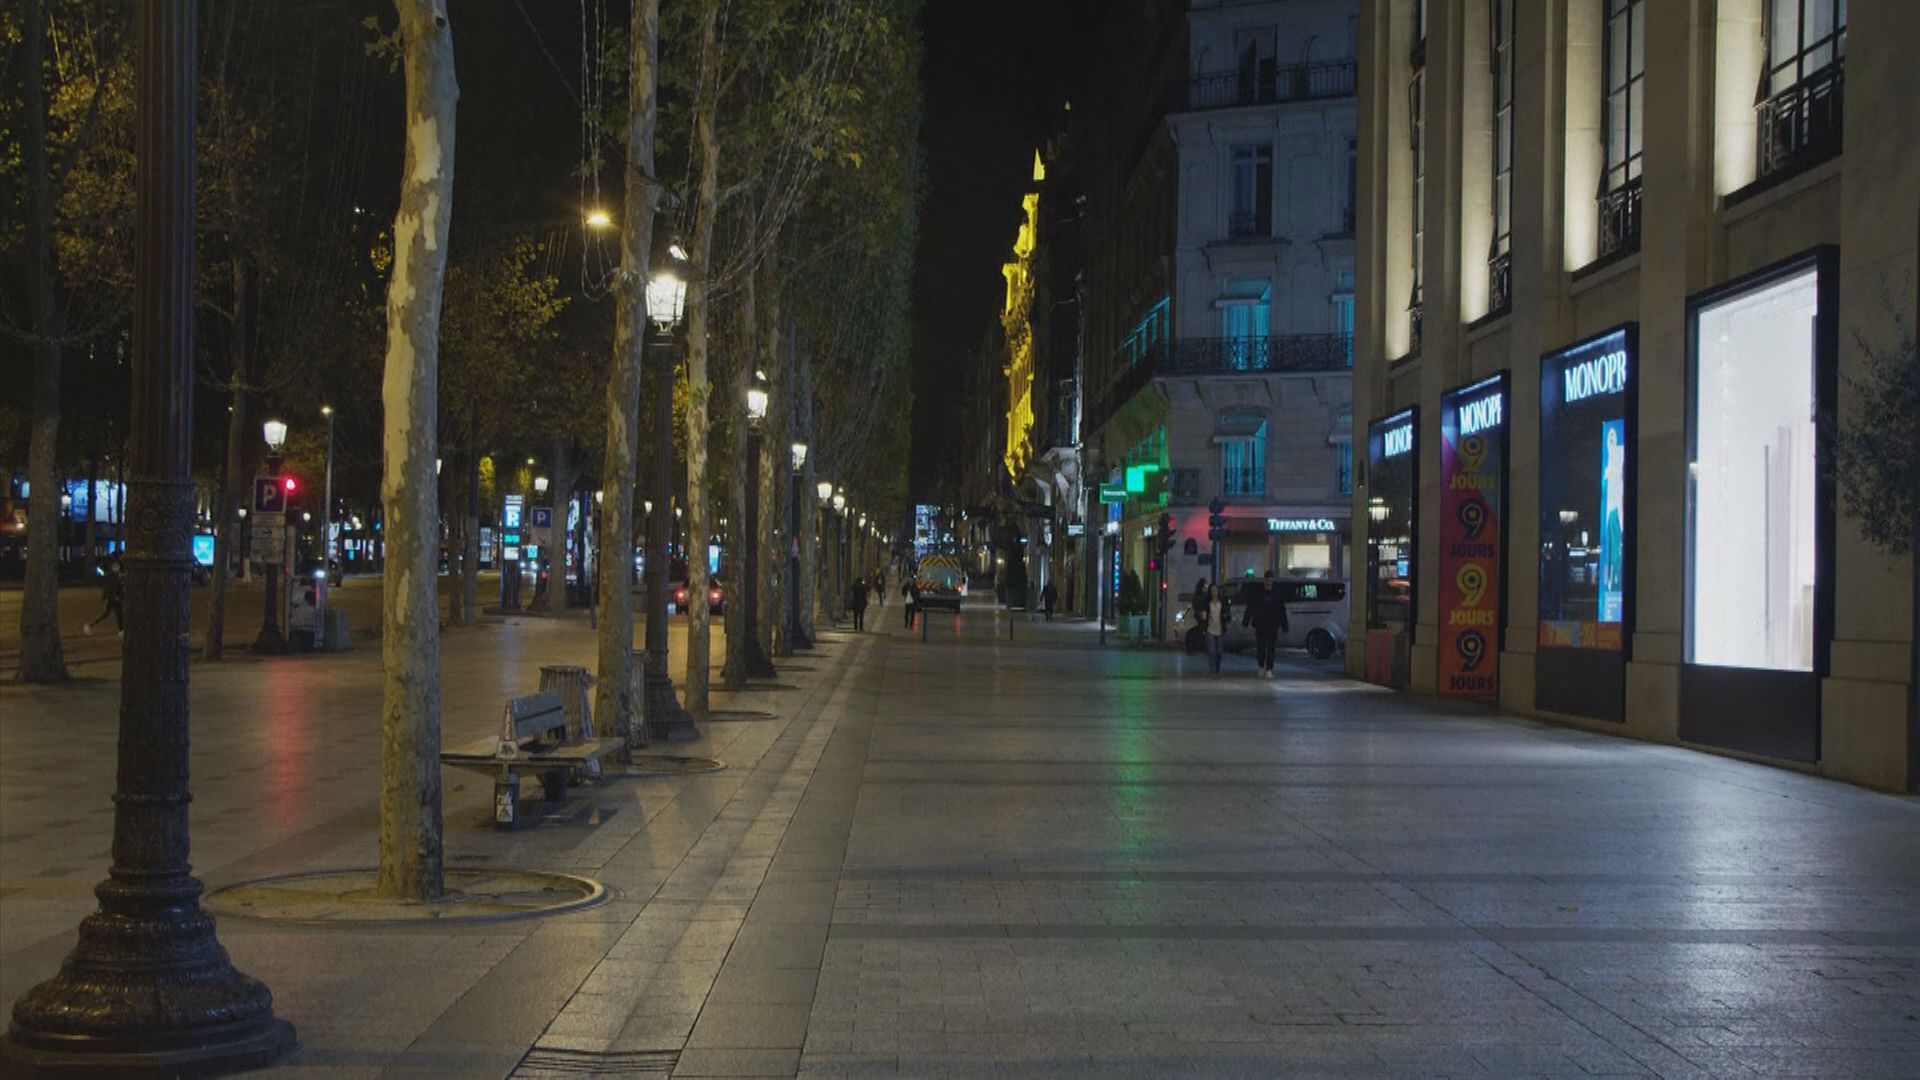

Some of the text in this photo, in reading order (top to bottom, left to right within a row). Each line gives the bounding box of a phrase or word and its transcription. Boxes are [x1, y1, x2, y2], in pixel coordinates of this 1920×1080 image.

[1458, 435, 1488, 471] 9
[1449, 473, 1495, 490] JOURS
[263, 485, 277, 506] P
[537, 511, 546, 524] P
[1457, 500, 1488, 540] 9
[1449, 542, 1495, 558] JOURS
[1456, 563, 1487, 607] 9
[1448, 608, 1494, 625] JOURS
[1456, 629, 1486, 671] 9
[1448, 674, 1493, 690] JOURS
